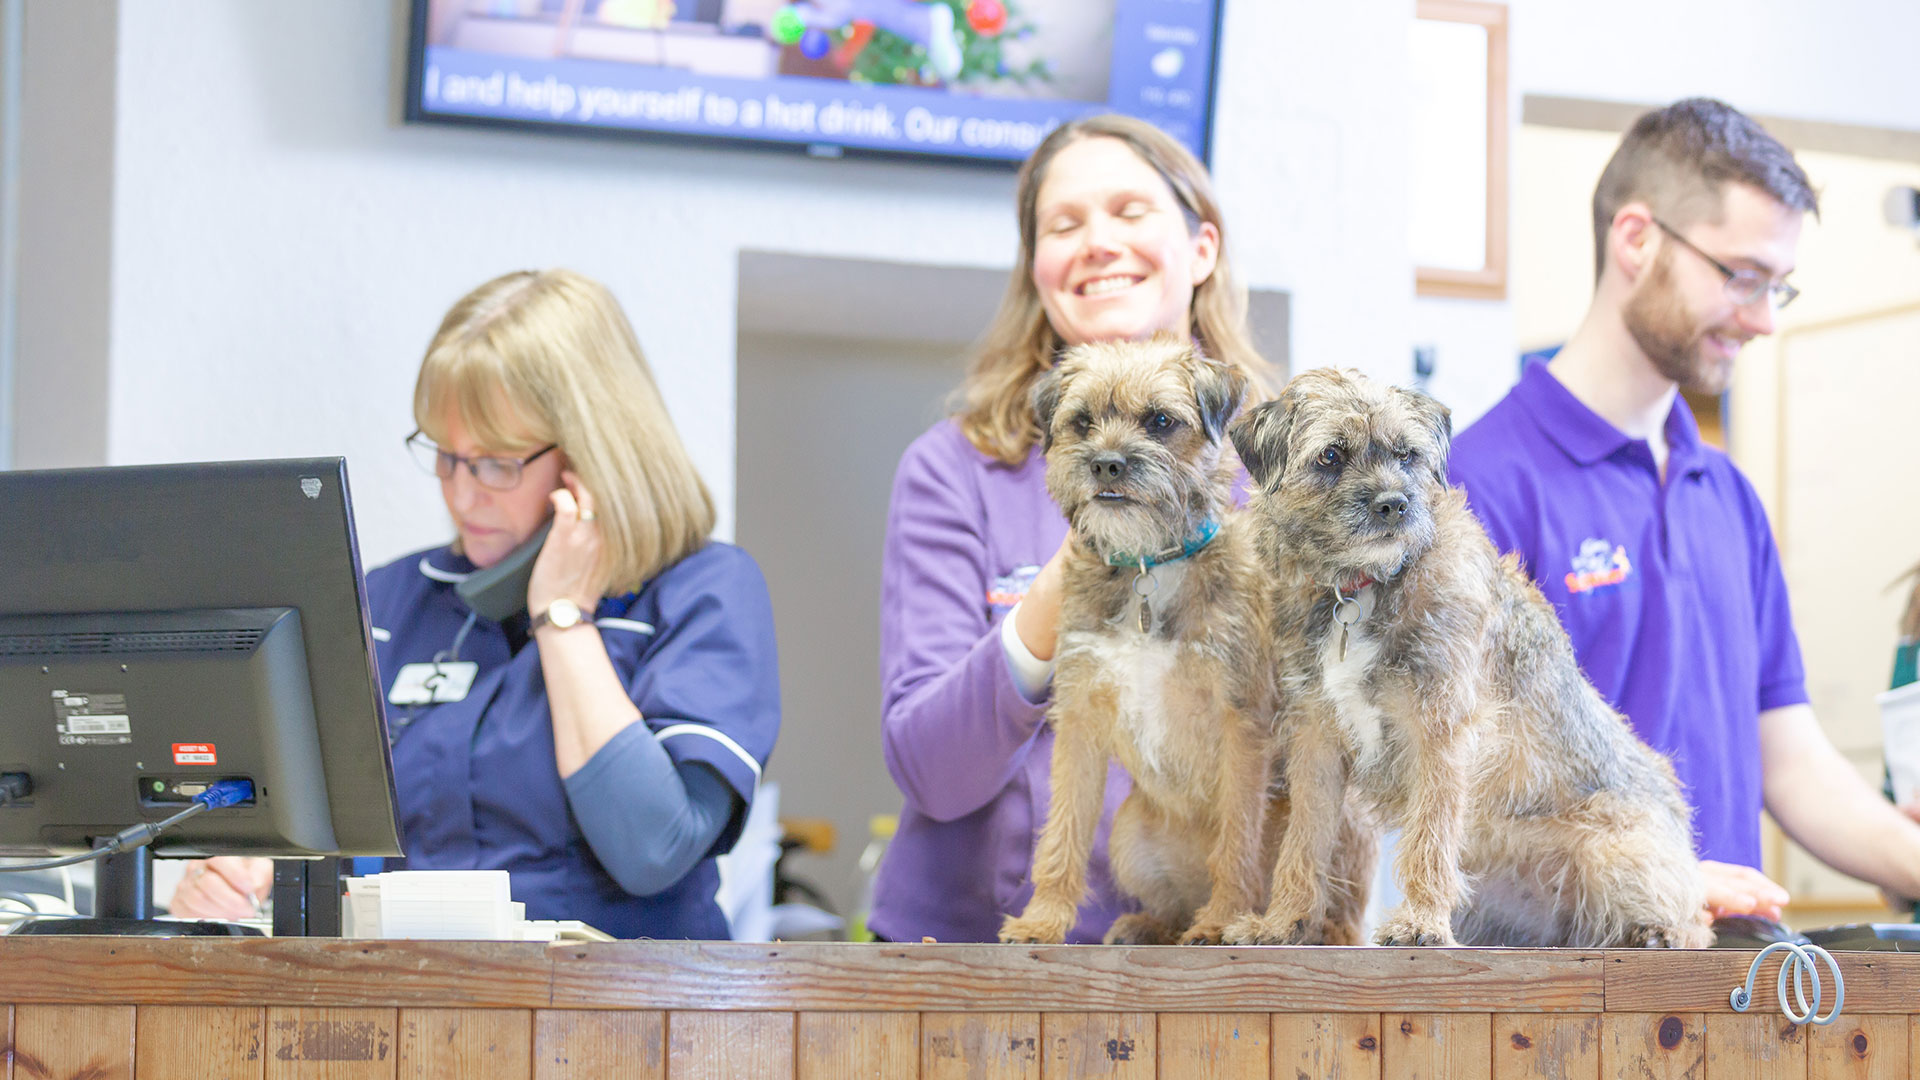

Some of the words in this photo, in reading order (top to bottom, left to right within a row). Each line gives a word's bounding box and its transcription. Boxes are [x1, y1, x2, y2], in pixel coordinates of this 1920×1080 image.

[441, 70, 503, 106] and
[506, 71, 576, 119] help
[577, 84, 703, 121] yourself
[704, 91, 738, 126] to
[739, 97, 763, 129] a
[765, 93, 816, 133] hot
[904, 105, 960, 144] Our
